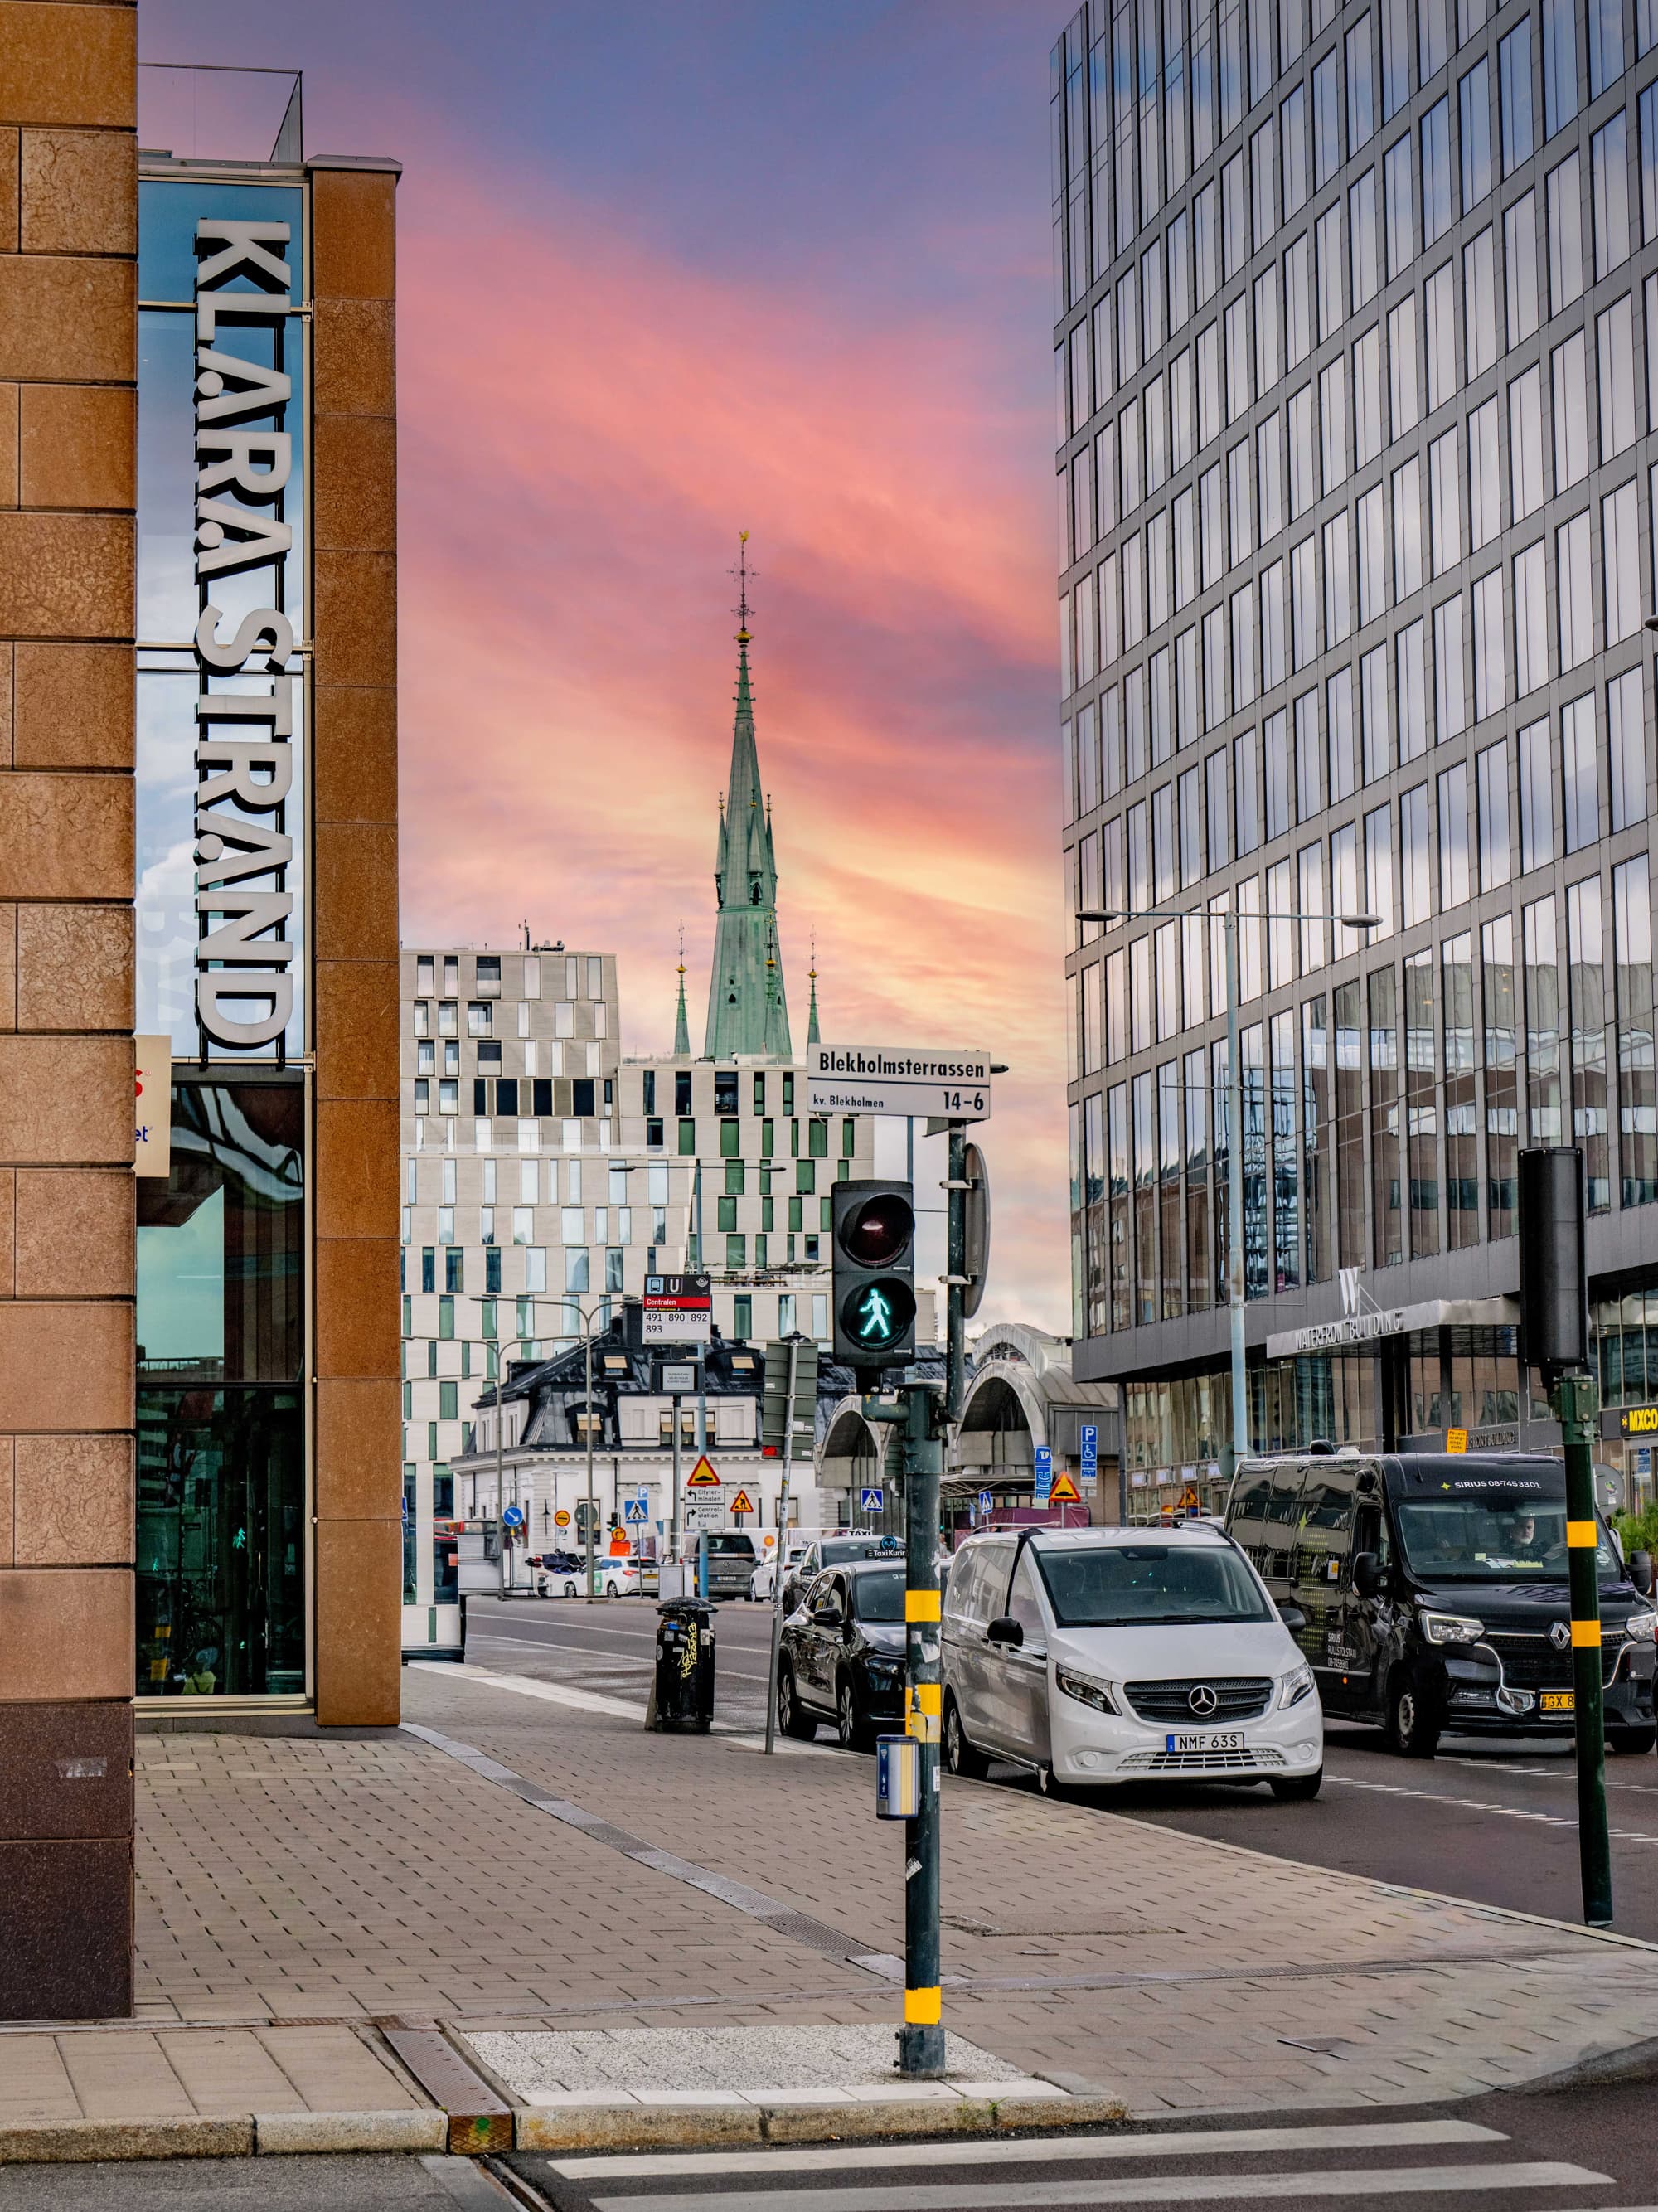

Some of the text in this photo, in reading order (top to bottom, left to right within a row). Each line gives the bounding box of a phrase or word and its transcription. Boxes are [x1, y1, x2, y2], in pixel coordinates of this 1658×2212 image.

[195, 219, 293, 1050] KLARA STRAND
[819, 1050, 984, 1078] Blekholmsterrassen
[813, 1094, 884, 1108] kv. Blekholmen
[670, 1278, 680, 1293] U
[646, 1313, 707, 1322] 491 890 892
[646, 1325, 662, 1333] 893
[1085, 1427, 1094, 1441] P
[1454, 1480, 1542, 1489] SIRIUS 08-7453301
[1180, 1734, 1238, 1749] NMF 63S
